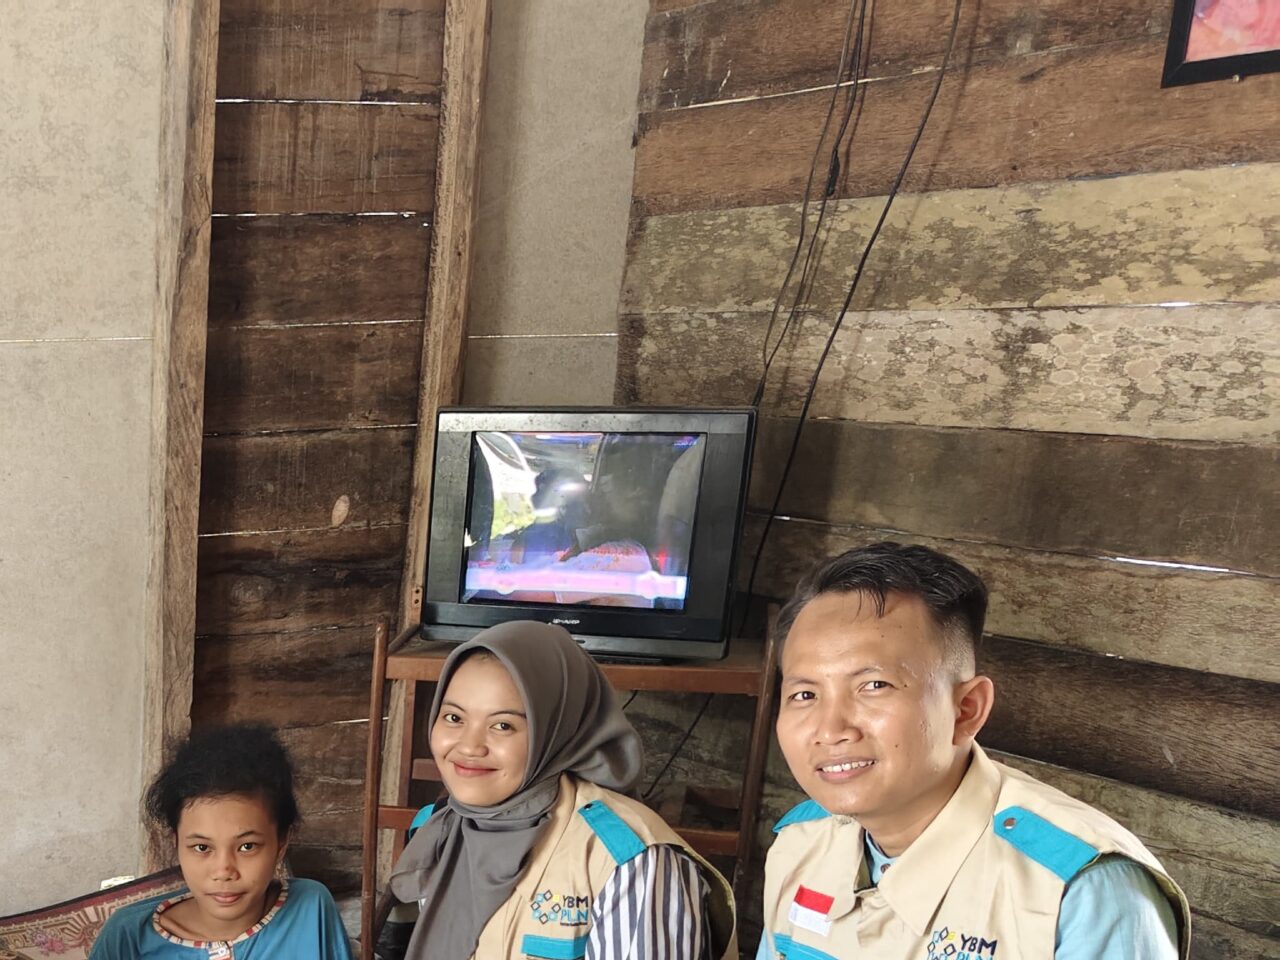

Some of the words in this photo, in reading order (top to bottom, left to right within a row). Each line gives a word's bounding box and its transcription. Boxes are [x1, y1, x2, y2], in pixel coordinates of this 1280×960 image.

[562, 895, 589, 909] YBM
[561, 909, 589, 921] PLN
[960, 933, 998, 956] YBM
